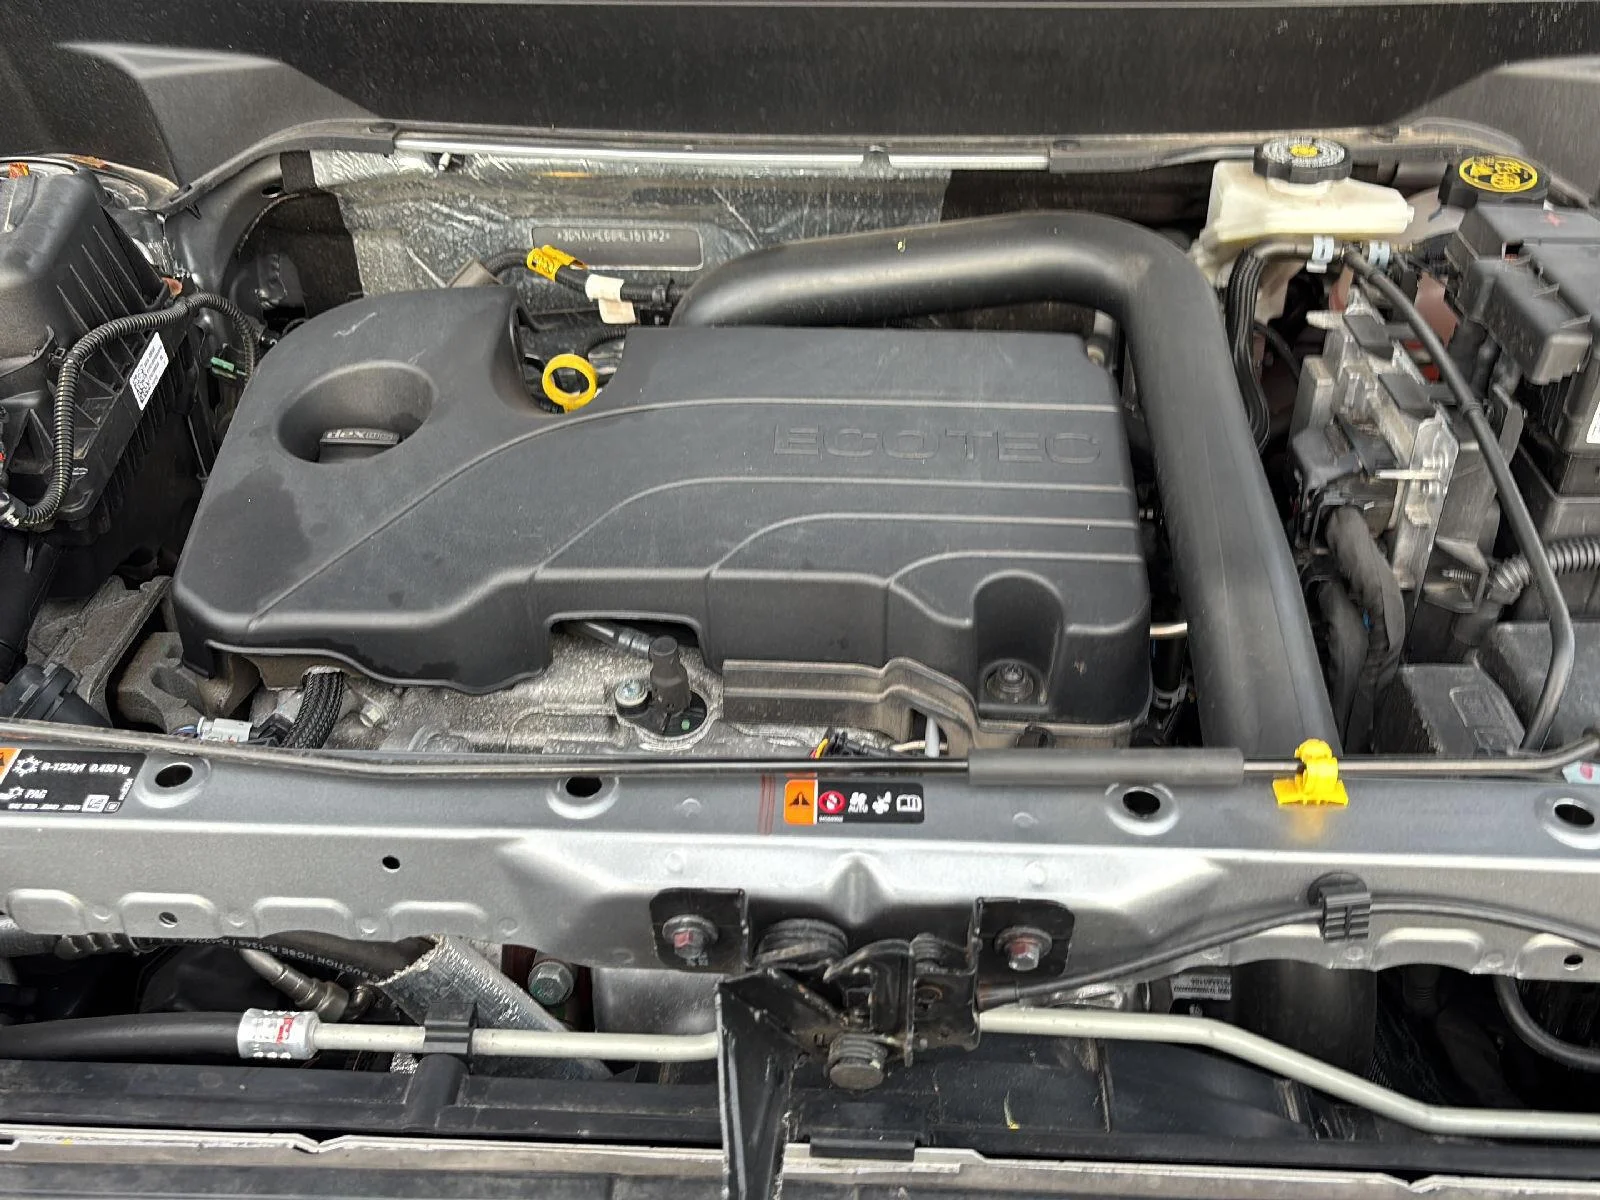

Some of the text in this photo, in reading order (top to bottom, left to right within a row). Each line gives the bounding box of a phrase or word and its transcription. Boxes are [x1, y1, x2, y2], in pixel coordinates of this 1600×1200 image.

[773, 424, 1101, 465] ECOTEC
[117, 764, 131, 775] kg
[24, 789, 48, 799] PAG
